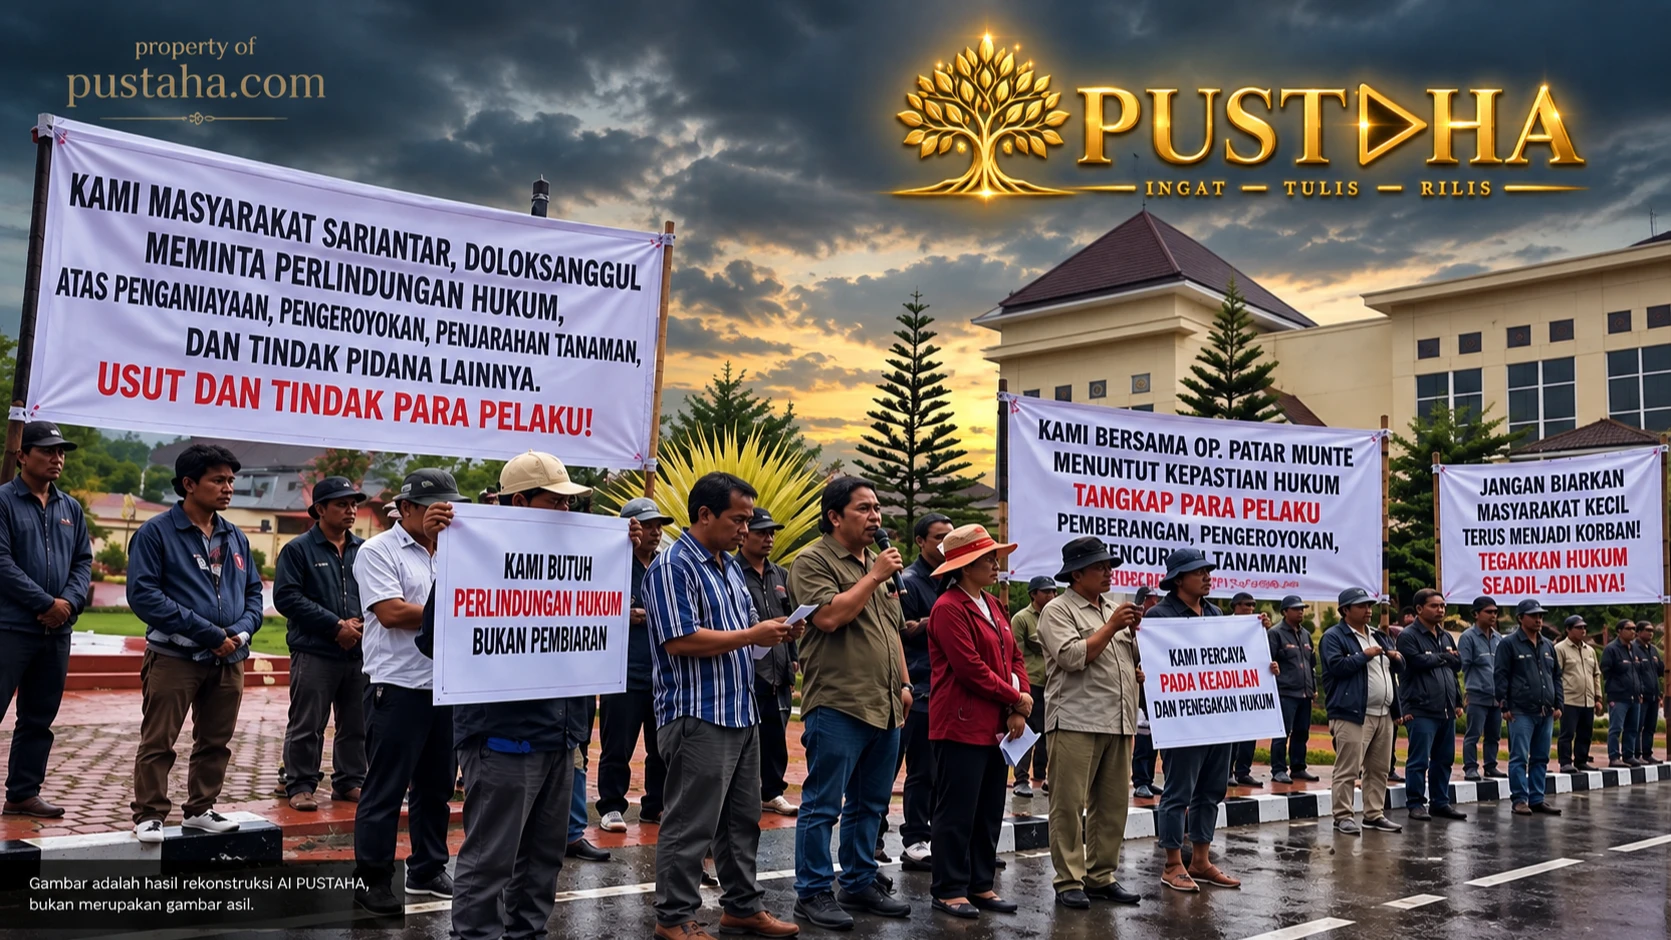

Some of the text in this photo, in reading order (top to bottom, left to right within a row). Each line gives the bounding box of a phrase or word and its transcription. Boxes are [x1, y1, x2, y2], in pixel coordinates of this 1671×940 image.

[69, 171, 642, 292] KAMI MASYARAKAT SARIANTAR, DOLOKSANGGUL
[144, 230, 565, 328] MEMINTA PERLINDUNGAN HUKUM,
[54, 266, 642, 369] ATAS PENGANIAYAAN, PENGEROYOKAN, PENJARAHAN TANAMAN,
[185, 326, 542, 393] DAN TINDAK PIDANA LAINNYA.
[97, 360, 593, 438] USUT DAN TINDAK PARA PELAKU!
[1038, 418, 1354, 468] KAMI BERSAMA OP. PATAR MUNTE
[1053, 450, 1340, 496] MENUNTUT KEPASTIAN HUKUM
[1479, 468, 1625, 497] JANGAN BIARKAN
[1072, 482, 1321, 525] TANGKAP PARA PELAKU
[1477, 494, 1630, 522] MASYARAKAT KECIL
[1056, 512, 1340, 555] PEMBERANGAN, PENGEROYOKAN,
[1461, 519, 1642, 547] TERUS MENJADI KORBAN!
[503, 552, 593, 582] KAMI BUTUH
[1211, 550, 1308, 576] TANAMAN!
[1478, 546, 1628, 571] TEGAKKAN HUKUM
[1482, 572, 1626, 596] SEADIL-ADILNYA!
[453, 587, 623, 618] PERLINDUNGAN HUKUM
[472, 625, 608, 656] BUKAN PEMBIARAN
[1168, 645, 1248, 667] KAMI PERCAYA
[1159, 668, 1260, 694] PADA KEADILAN
[1153, 692, 1275, 719] DAN PENEGAKAN HUKUM
